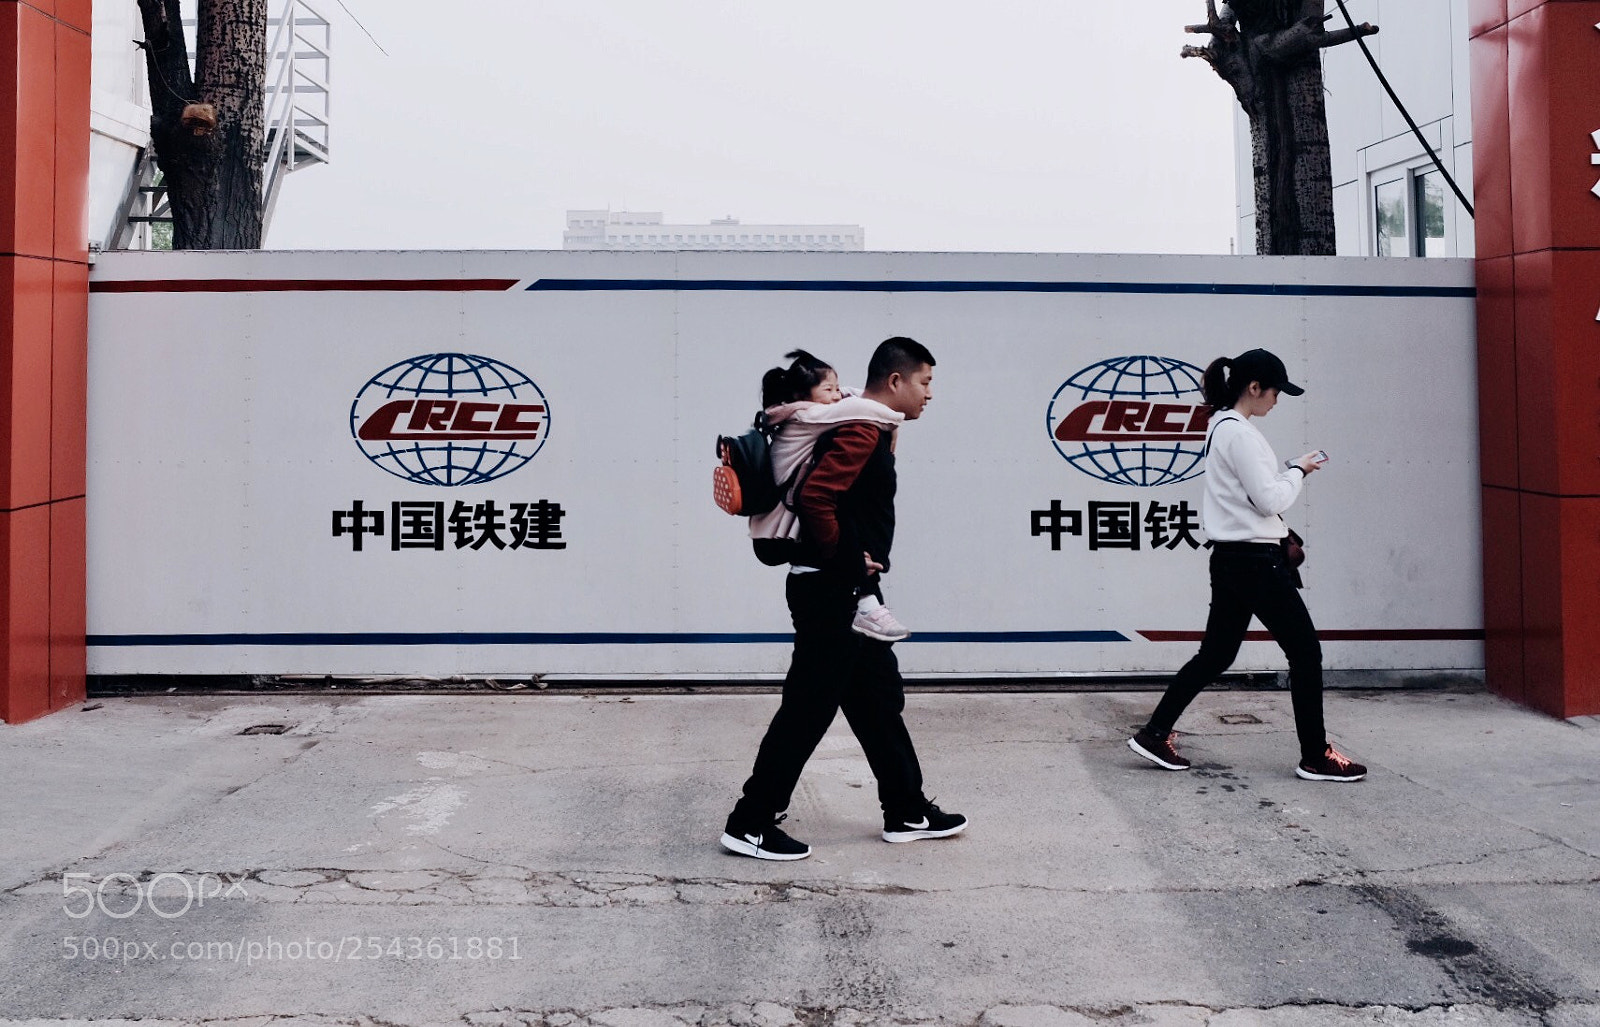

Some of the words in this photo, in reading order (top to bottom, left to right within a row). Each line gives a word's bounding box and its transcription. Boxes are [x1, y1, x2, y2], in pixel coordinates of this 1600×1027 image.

[358, 399, 545, 441] CRCC
[332, 499, 567, 551] 中国铁建
[1030, 499, 1213, 551] 中国铁
